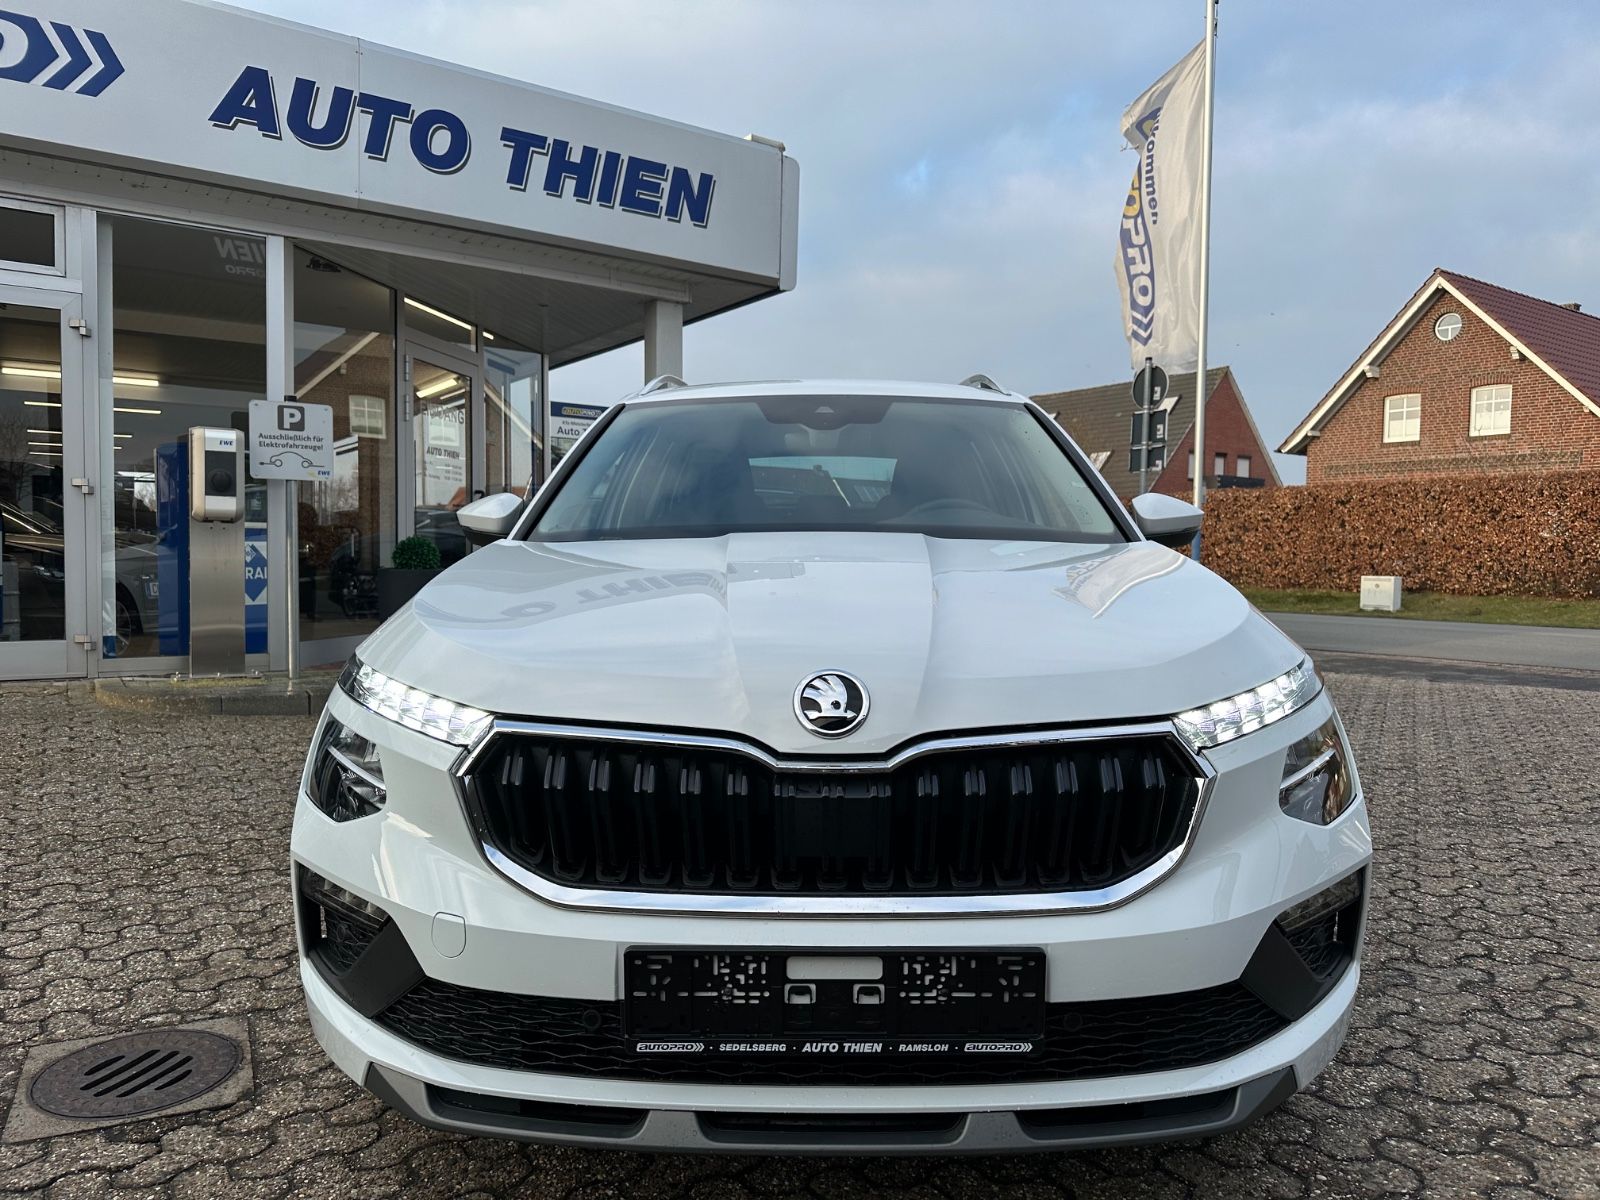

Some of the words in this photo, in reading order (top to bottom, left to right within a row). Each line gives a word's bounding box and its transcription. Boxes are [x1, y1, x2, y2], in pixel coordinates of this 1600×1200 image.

[208, 65, 470, 175] AUTO
[500, 126, 715, 229] THIEN
[283, 407, 302, 430] P
[557, 425, 580, 436] Auto
[258, 433, 312, 444] Ausschließlich
[313, 435, 324, 443] für
[426, 446, 442, 457] AUTO
[719, 1043, 787, 1052] SEDELSBERG
[802, 1042, 839, 1053] AUTO
[843, 1042, 883, 1053] THIEN
[899, 1043, 949, 1052] RAMSLOH
